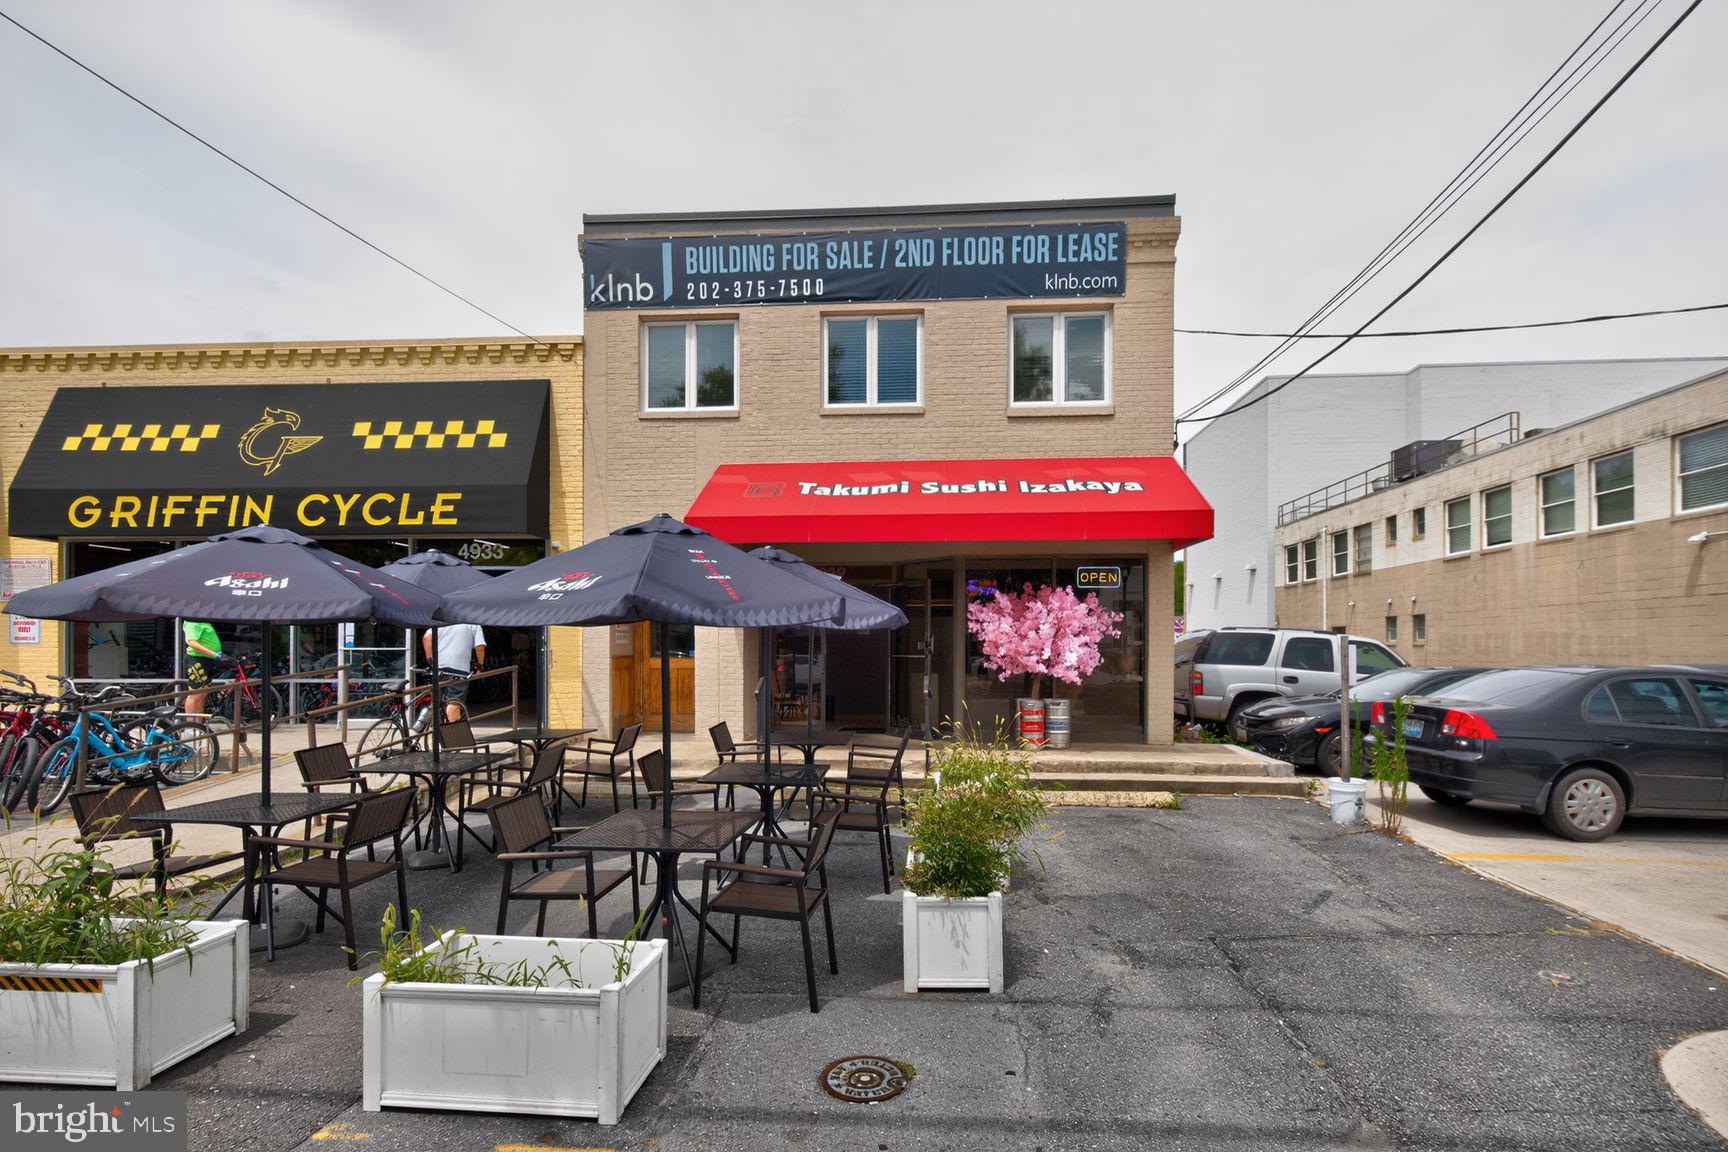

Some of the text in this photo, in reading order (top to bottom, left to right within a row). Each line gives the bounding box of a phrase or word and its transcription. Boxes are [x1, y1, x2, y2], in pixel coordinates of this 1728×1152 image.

[685, 243, 776, 275] BUILDING
[782, 241, 820, 271] FOR
[826, 240, 873, 270] SALE
[894, 238, 935, 268] 2ND
[942, 236, 1004, 266] FLOOR
[1012, 234, 1050, 264] FOR
[1057, 232, 1119, 263] LEASE
[590, 272, 654, 302] klnb
[687, 278, 825, 300] 202-375-7500
[1045, 272, 1118, 290] klnb.com
[798, 480, 910, 496] Takumi
[920, 480, 1008, 494] Sushi
[1018, 479, 1145, 495] Izakaya
[68, 492, 463, 528] GRIFFIN CYCLE
[458, 543, 504, 559] 4933
[1080, 572, 1118, 583] OPEN
